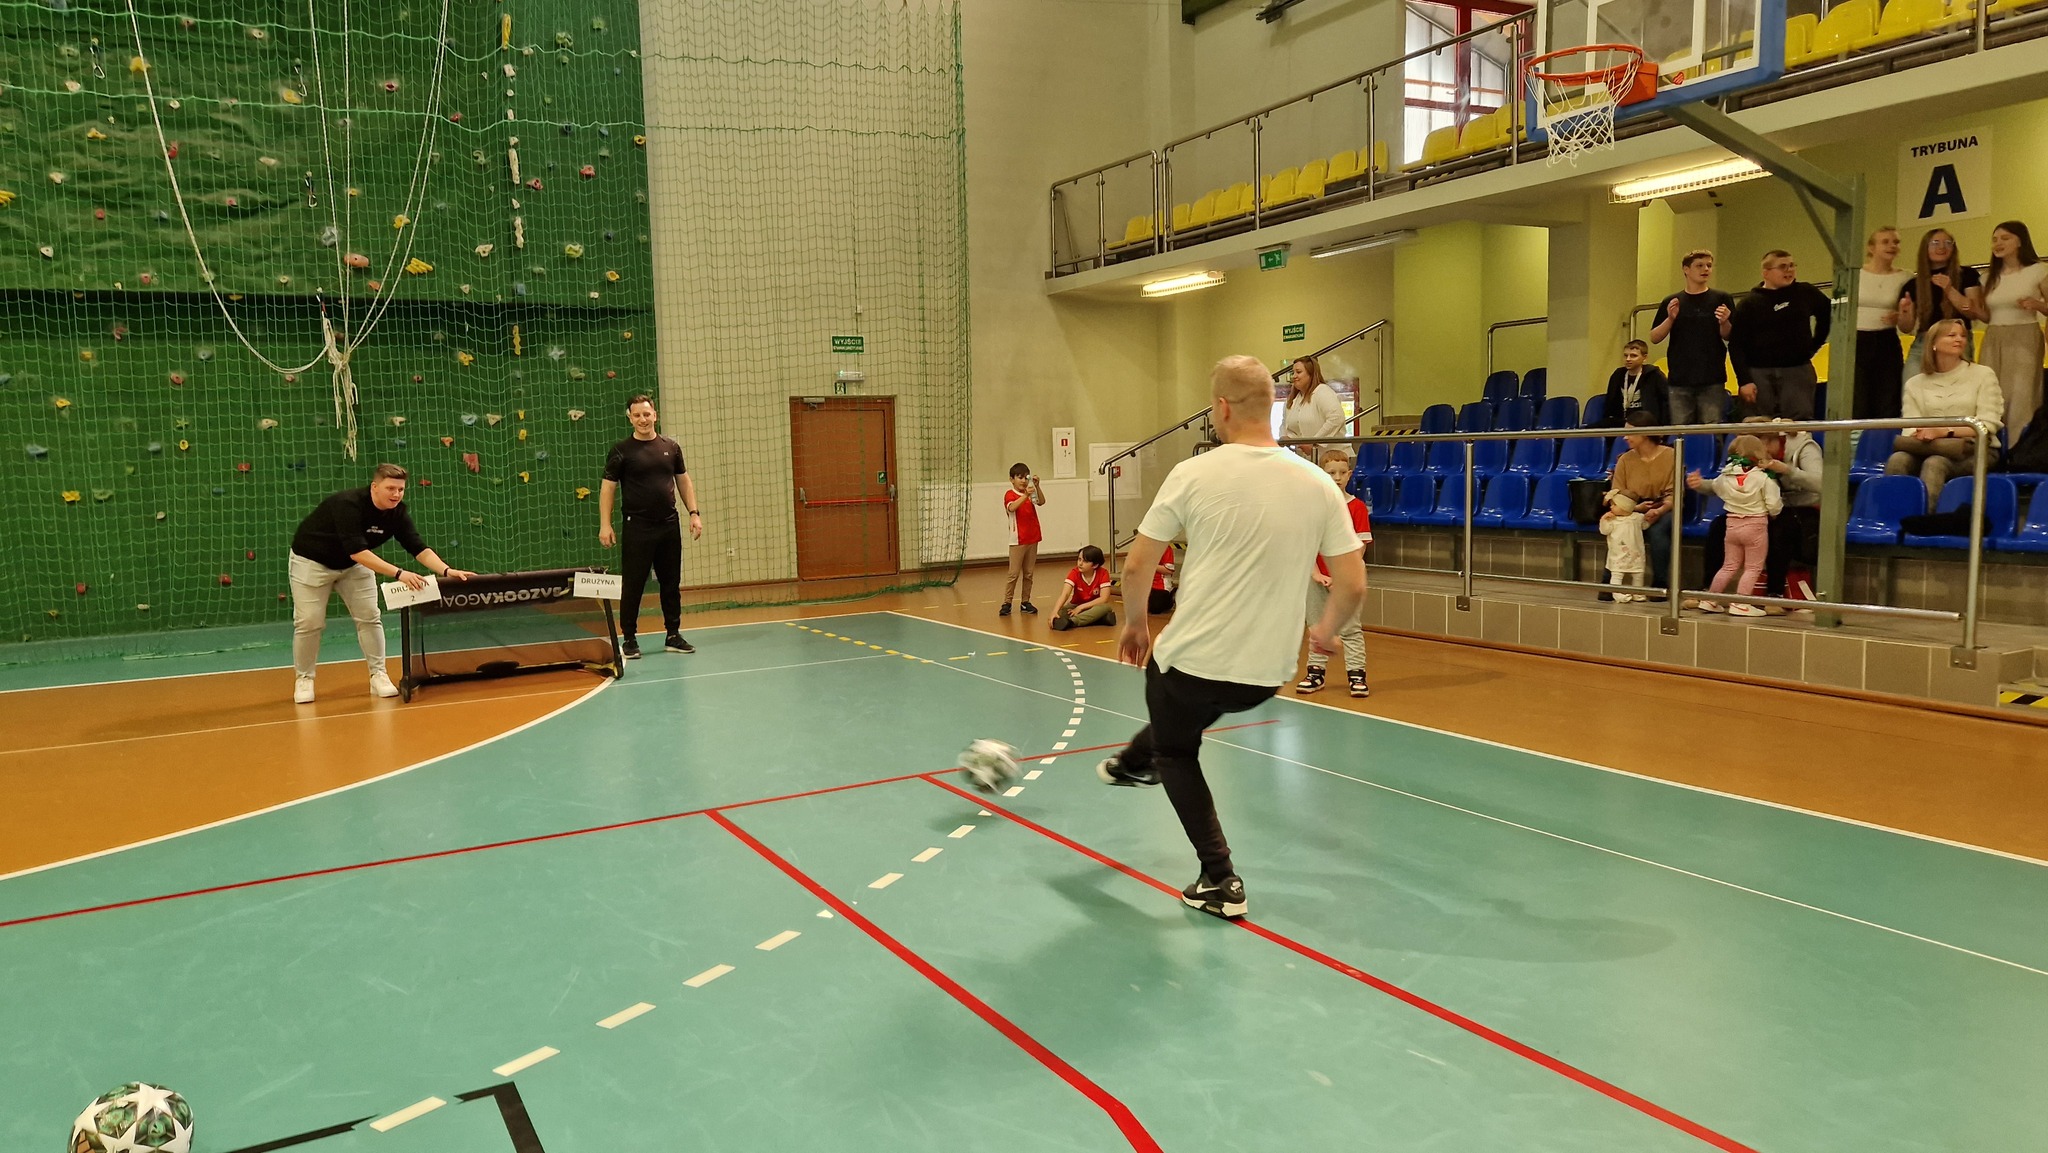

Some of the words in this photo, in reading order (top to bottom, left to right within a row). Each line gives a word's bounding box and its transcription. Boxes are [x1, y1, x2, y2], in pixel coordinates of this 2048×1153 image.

[1911, 135, 1978, 158] TRYBUNA
[1918, 163, 1967, 219] A
[390, 581, 430, 594] DRUA
[581, 577, 616, 585] DRUŻYNA
